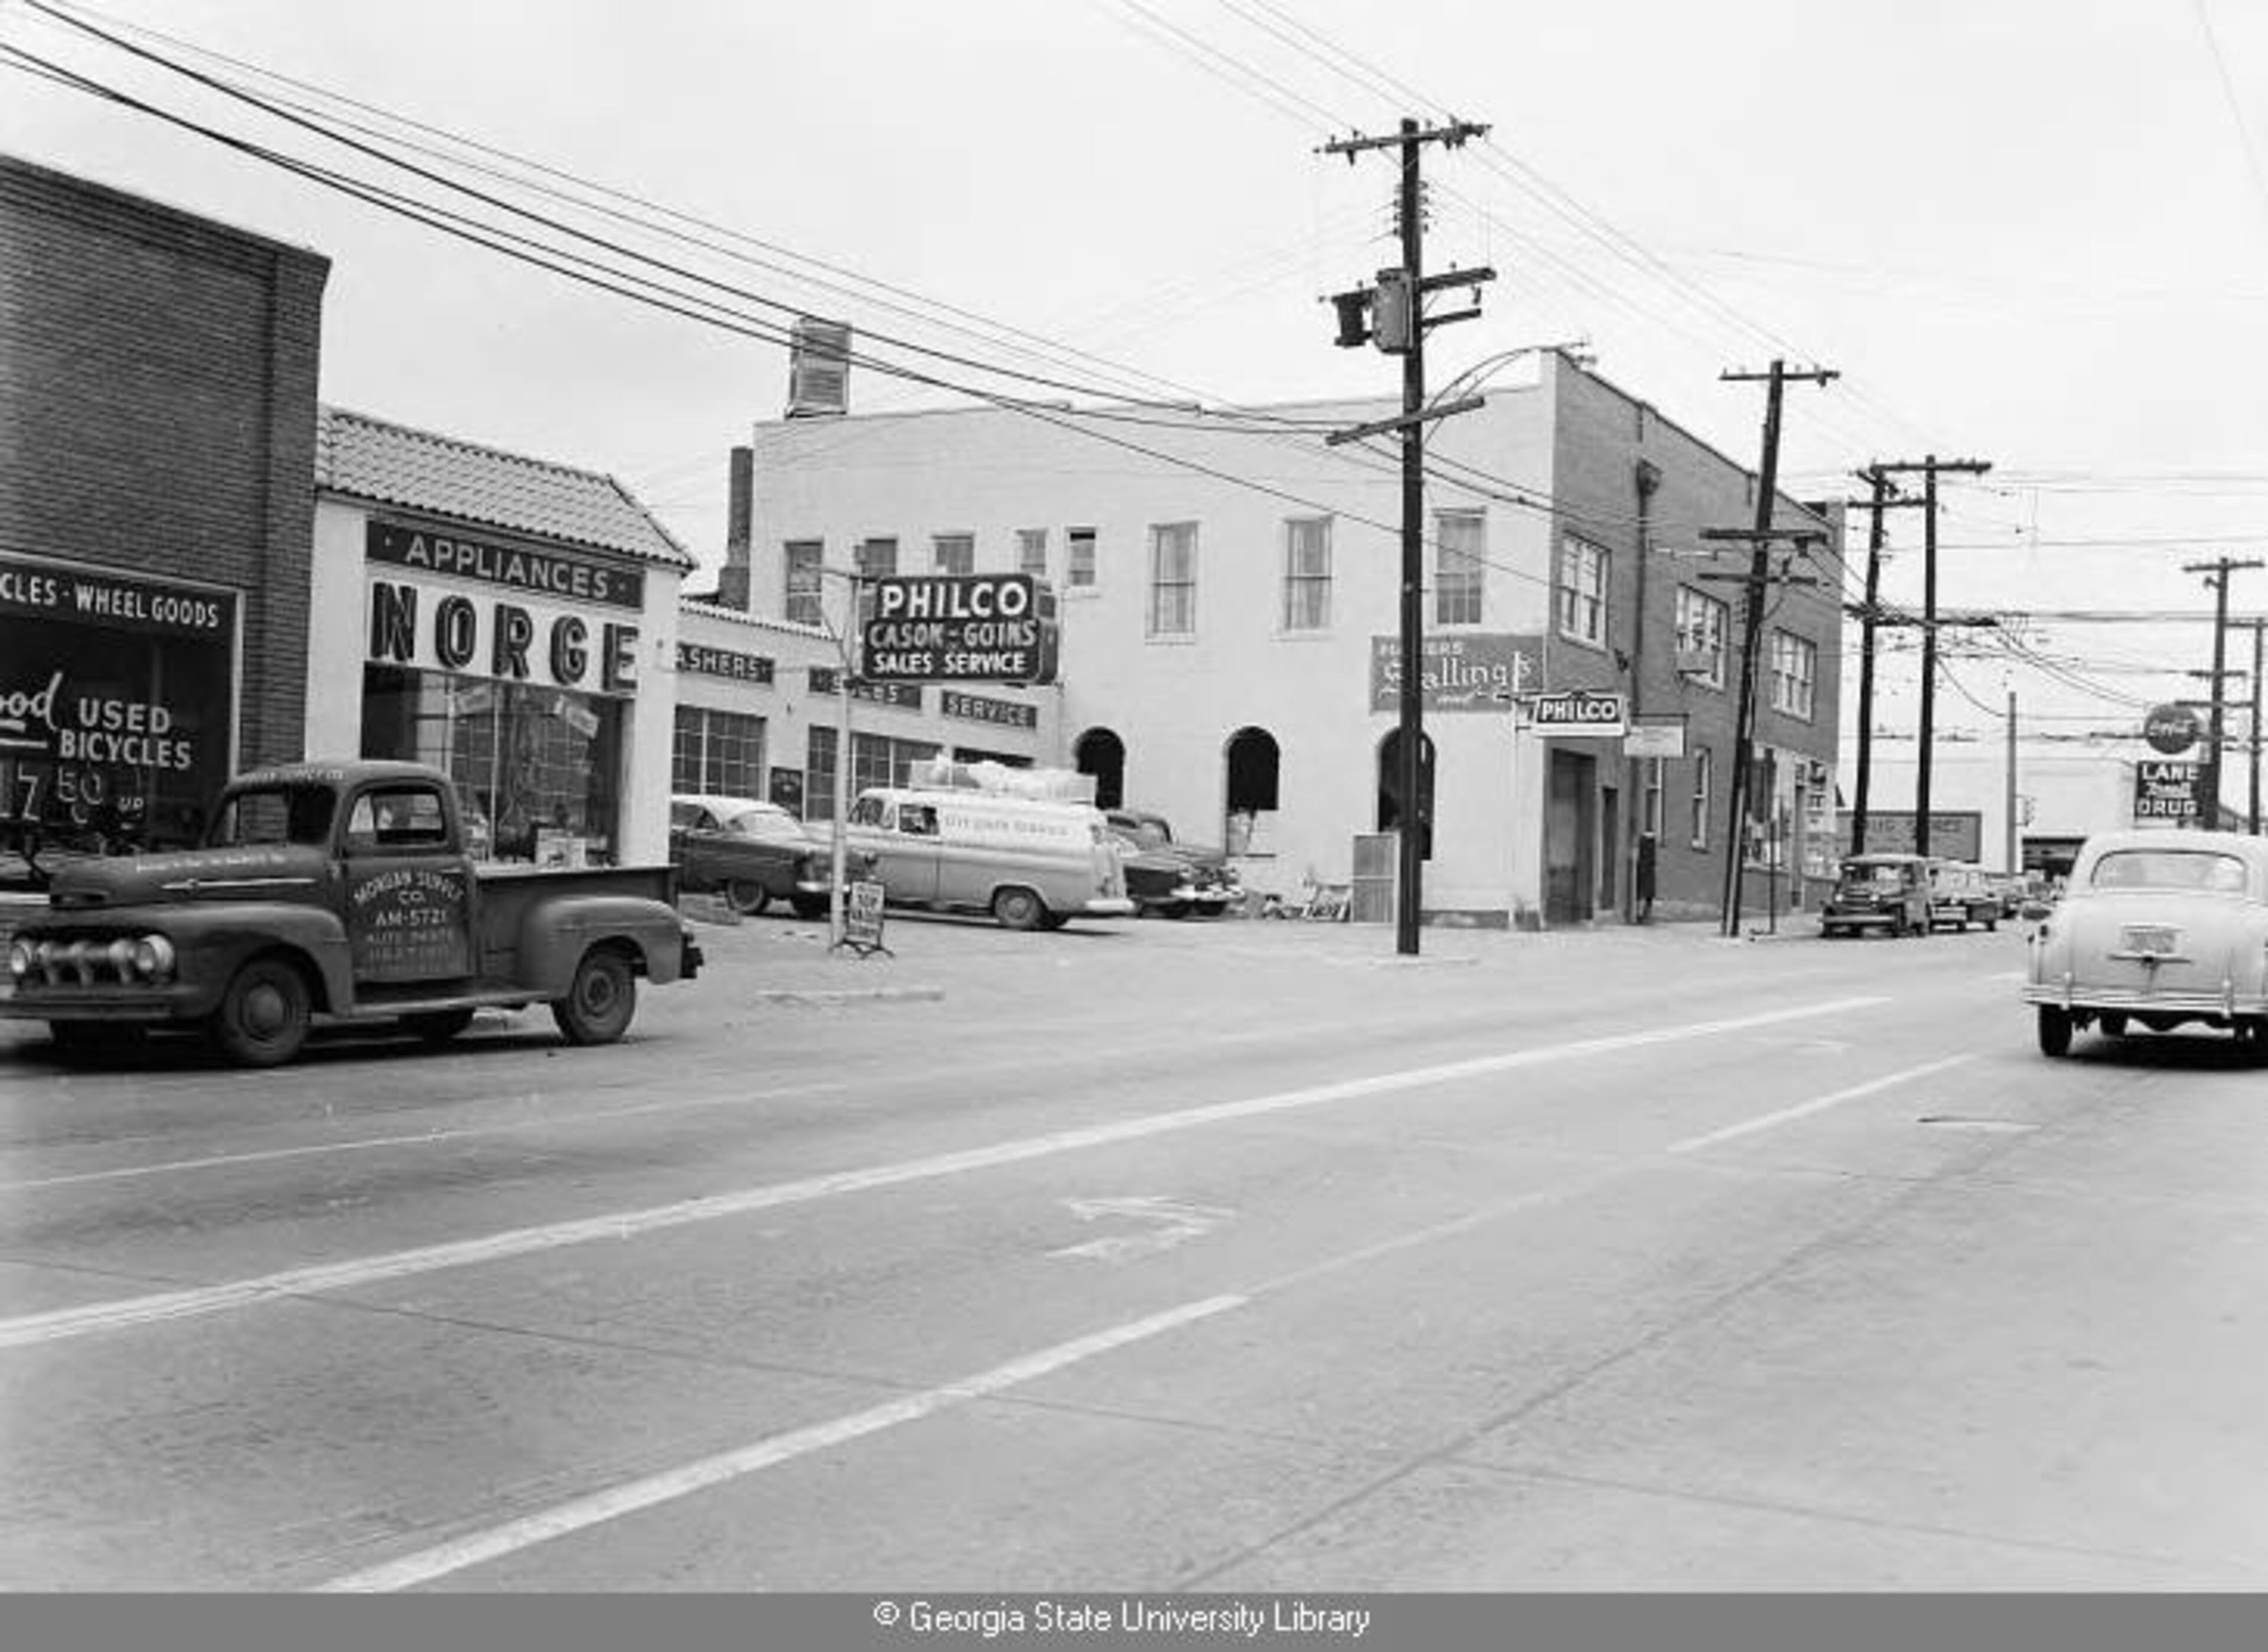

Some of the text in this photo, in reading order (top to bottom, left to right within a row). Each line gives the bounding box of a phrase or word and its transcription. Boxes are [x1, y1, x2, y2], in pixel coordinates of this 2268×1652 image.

[406, 535, 609, 599] APPLIANCES
[74, 582, 146, 619] WHEEL
[151, 595, 219, 627] GOODS
[881, 582, 1027, 618] PHILCO
[370, 581, 639, 691] NORGE
[873, 652, 1026, 674] SALES SERVICE
[0, 672, 170, 733] od USED
[947, 695, 1028, 726] SERVICE
[1542, 700, 1616, 721] PHILCO
[60, 728, 192, 770] BICYCLES
[2142, 763, 2199, 780] LANE
[2136, 799, 2198, 815] DRUG
